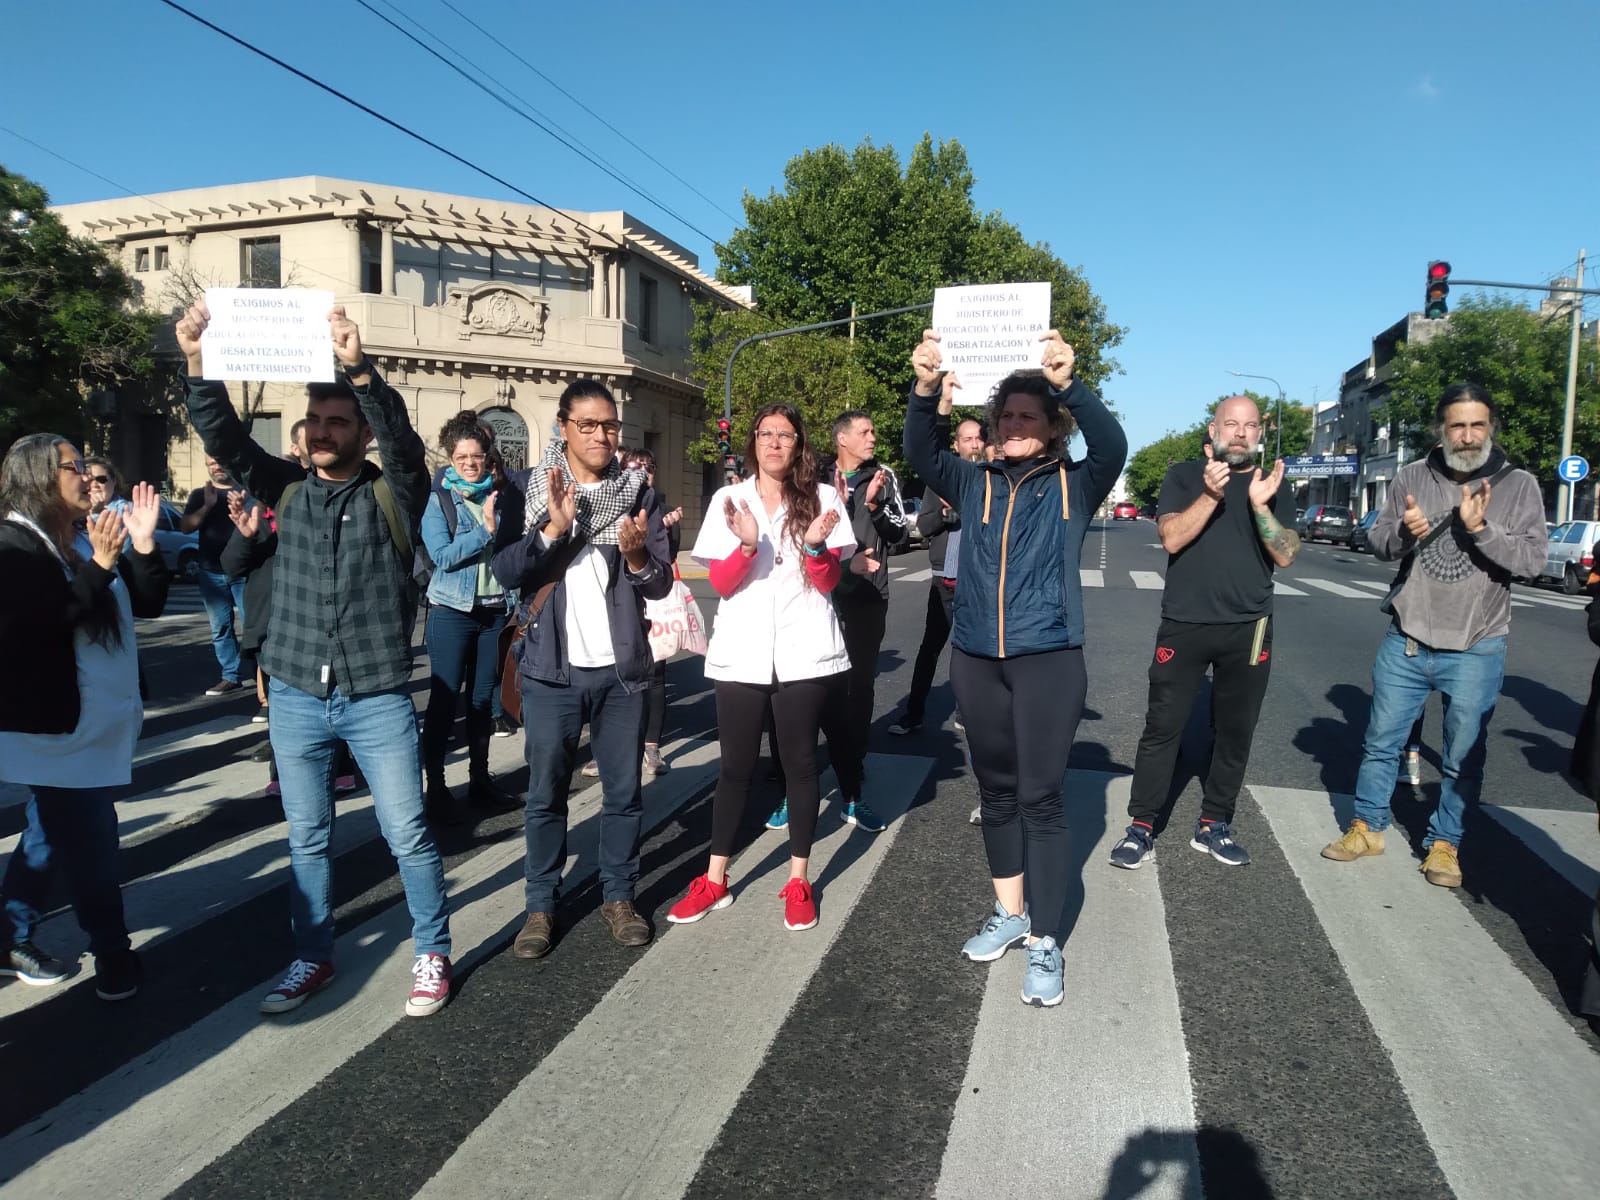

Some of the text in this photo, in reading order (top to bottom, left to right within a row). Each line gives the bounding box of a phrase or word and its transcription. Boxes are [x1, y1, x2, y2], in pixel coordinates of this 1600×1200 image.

[233, 298, 301, 309] EXIGIMOS AL
[960, 292, 1021, 304] EXIGIMOS AL
[1011, 308, 1024, 317] DE
[292, 316, 304, 325] DE
[992, 323, 999, 333] Y
[1001, 323, 1014, 333] AL
[946, 338, 1033, 349] DESRATIZACION Y
[220, 346, 314, 358] DESRATIZACION Y
[951, 354, 1029, 364] MANTENIMIENTO
[225, 363, 312, 374] MANTENIMIENTO
[1566, 459, 1582, 478] E
